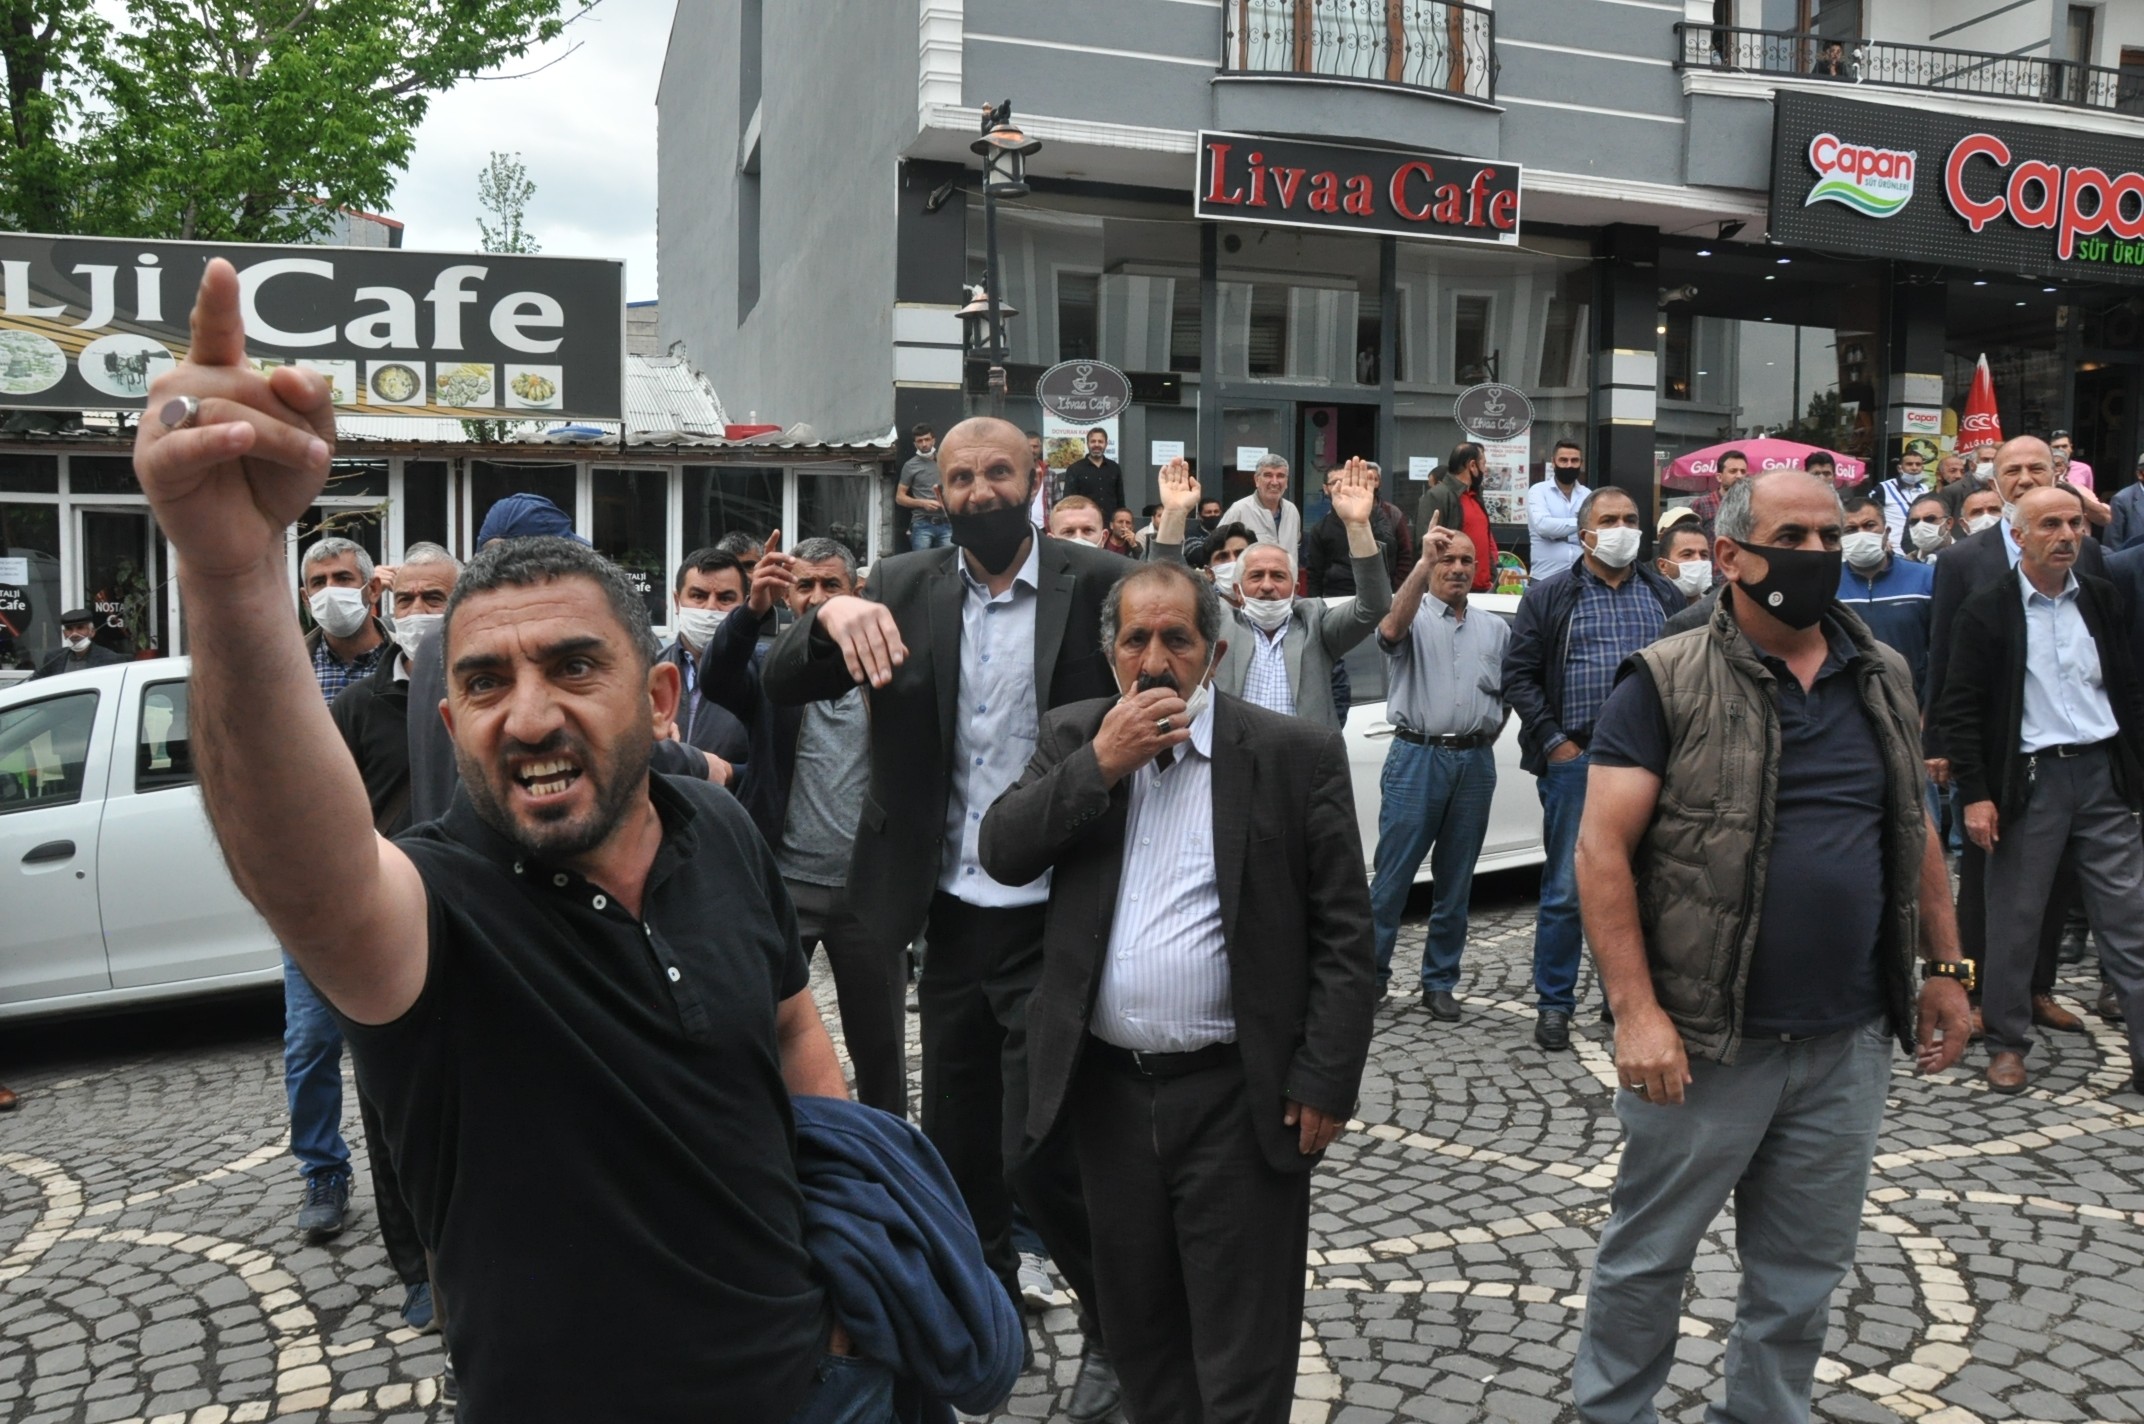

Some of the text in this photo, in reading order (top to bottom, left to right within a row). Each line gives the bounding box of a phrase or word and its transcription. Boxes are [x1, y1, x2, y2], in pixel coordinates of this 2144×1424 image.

[1812, 137, 1912, 186] Çapan
[1203, 143, 1517, 230] Livaa Cafe
[1864, 178, 1910, 191] SÜT ÜRÜNLERİ
[2078, 238, 2109, 261] SÜT
[236, 257, 565, 354] Cafe
[1057, 395, 1111, 416] Livaa Cafe
[1471, 416, 1517, 435] Livaa Cafe
[1835, 463, 1856, 479] Golf
